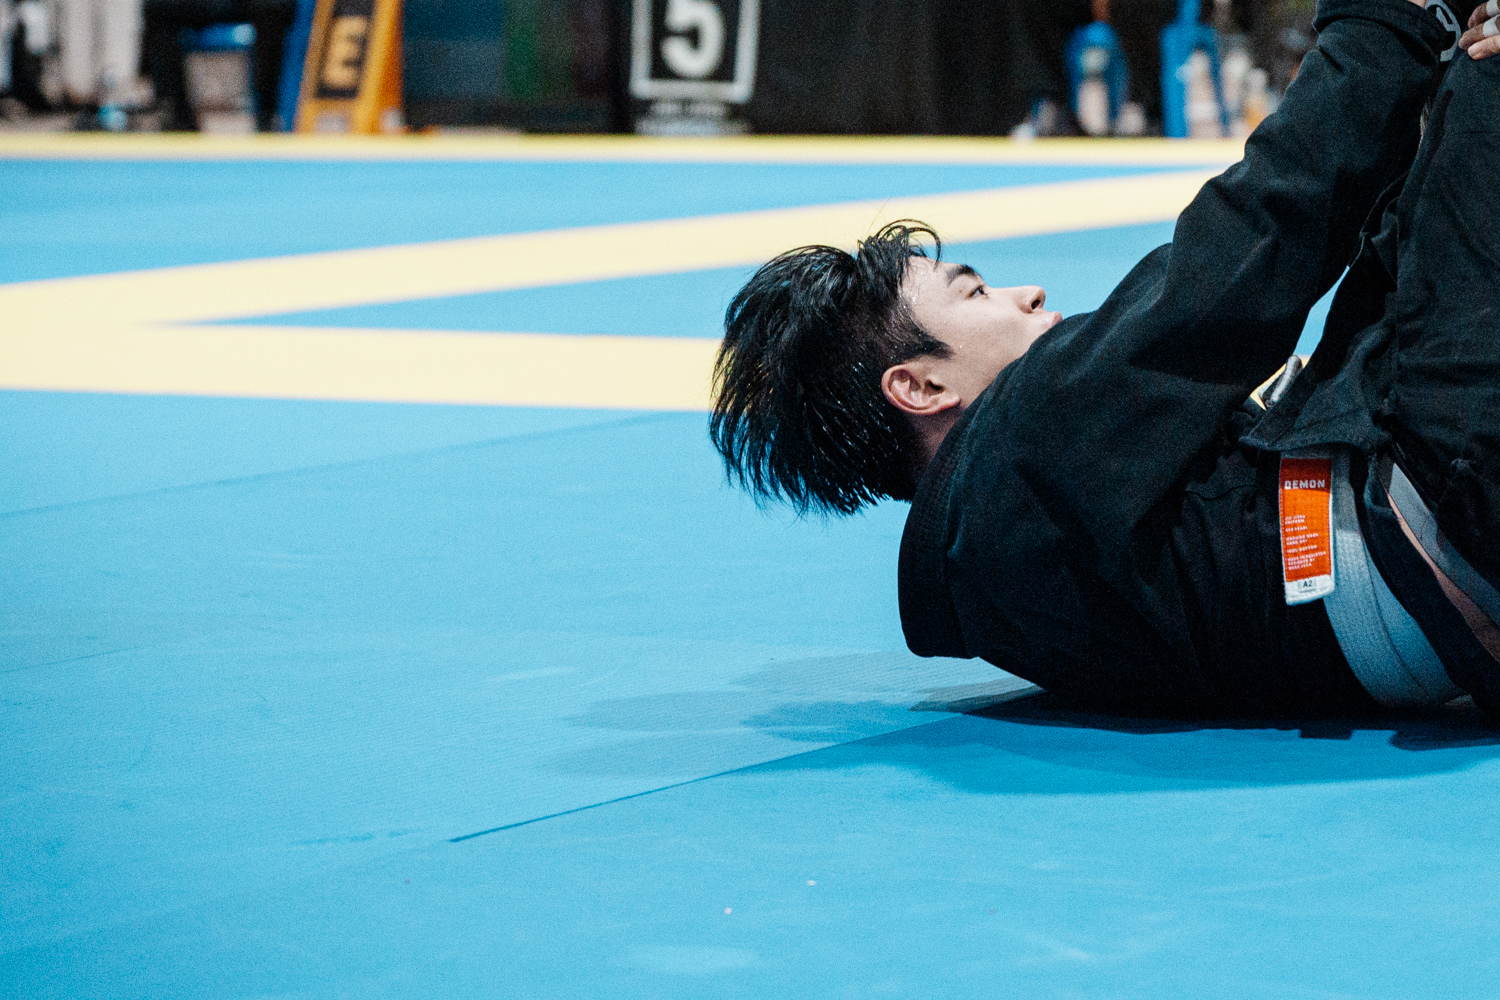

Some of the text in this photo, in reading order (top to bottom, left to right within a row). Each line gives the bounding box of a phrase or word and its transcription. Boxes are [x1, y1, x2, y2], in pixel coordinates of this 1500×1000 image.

[324, 15, 368, 87] E
[1284, 480, 1326, 490] DEMON
[1303, 580, 1313, 588] A2
